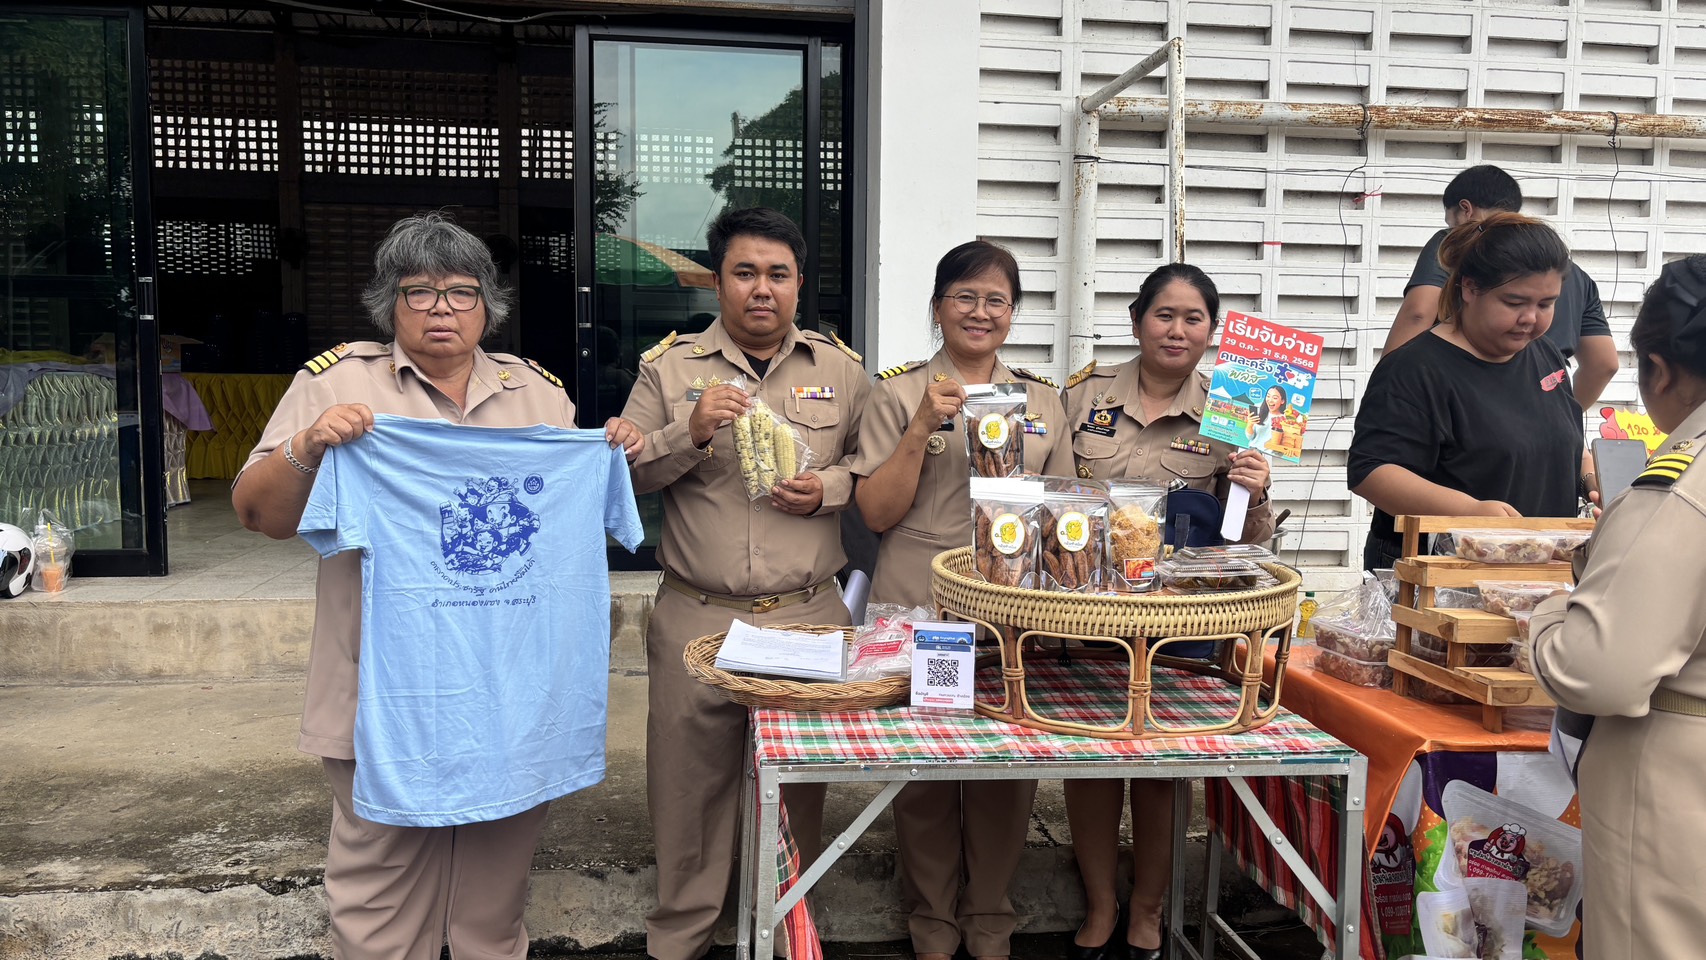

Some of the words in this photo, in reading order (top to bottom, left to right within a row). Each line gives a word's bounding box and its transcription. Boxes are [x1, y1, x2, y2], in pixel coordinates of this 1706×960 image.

[1227, 316, 1319, 356] เริ่มจับจ่าย
[1219, 351, 1274, 373] คนละครึ่ง
[1225, 337, 1236, 346] 29
[1262, 347, 1272, 356] 31
[1273, 352, 1289, 362] ธ.ค.
[1292, 356, 1315, 368] 2568
[1228, 369, 1267, 384] พลัส
[1627, 423, 1649, 436] 120
